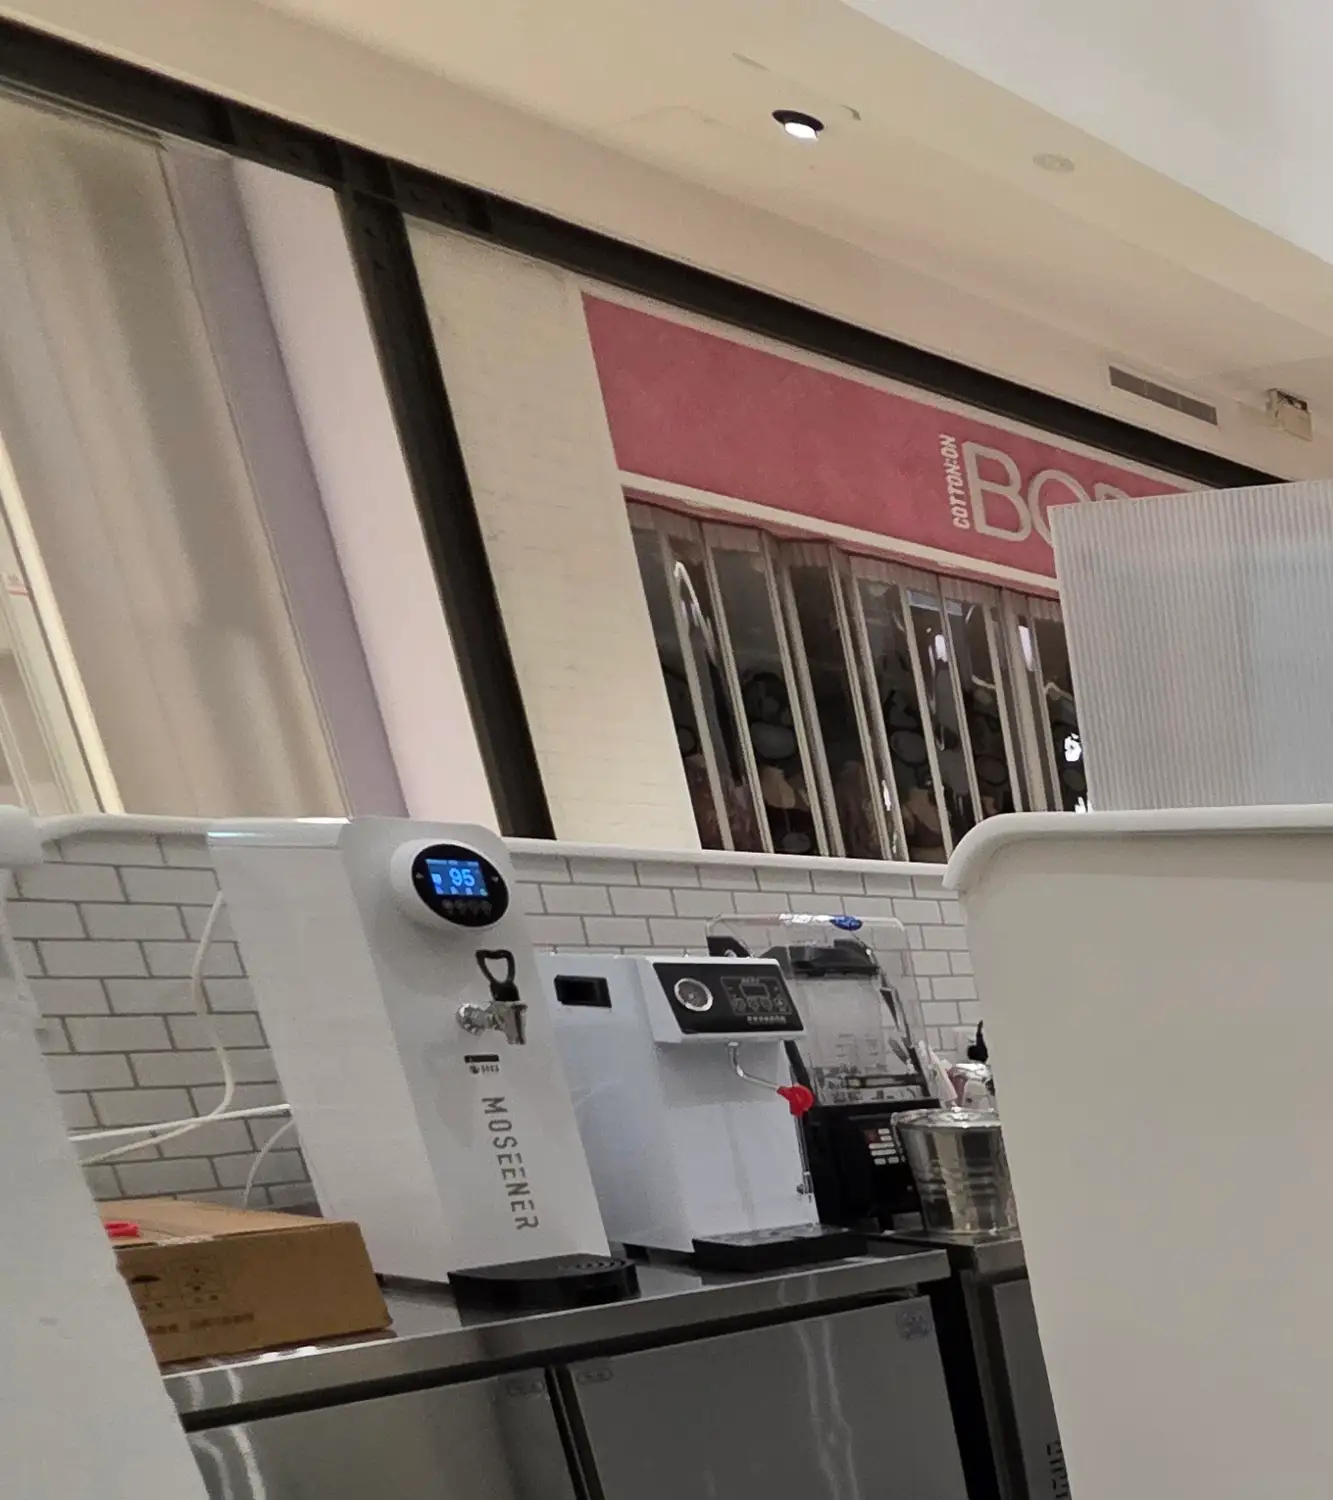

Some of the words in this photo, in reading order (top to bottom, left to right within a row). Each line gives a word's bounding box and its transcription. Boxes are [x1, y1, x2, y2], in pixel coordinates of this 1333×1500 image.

[961, 441, 1132, 548] BO
[449, 868, 475, 887] 95
[481, 1096, 539, 1230] MOSEENER
